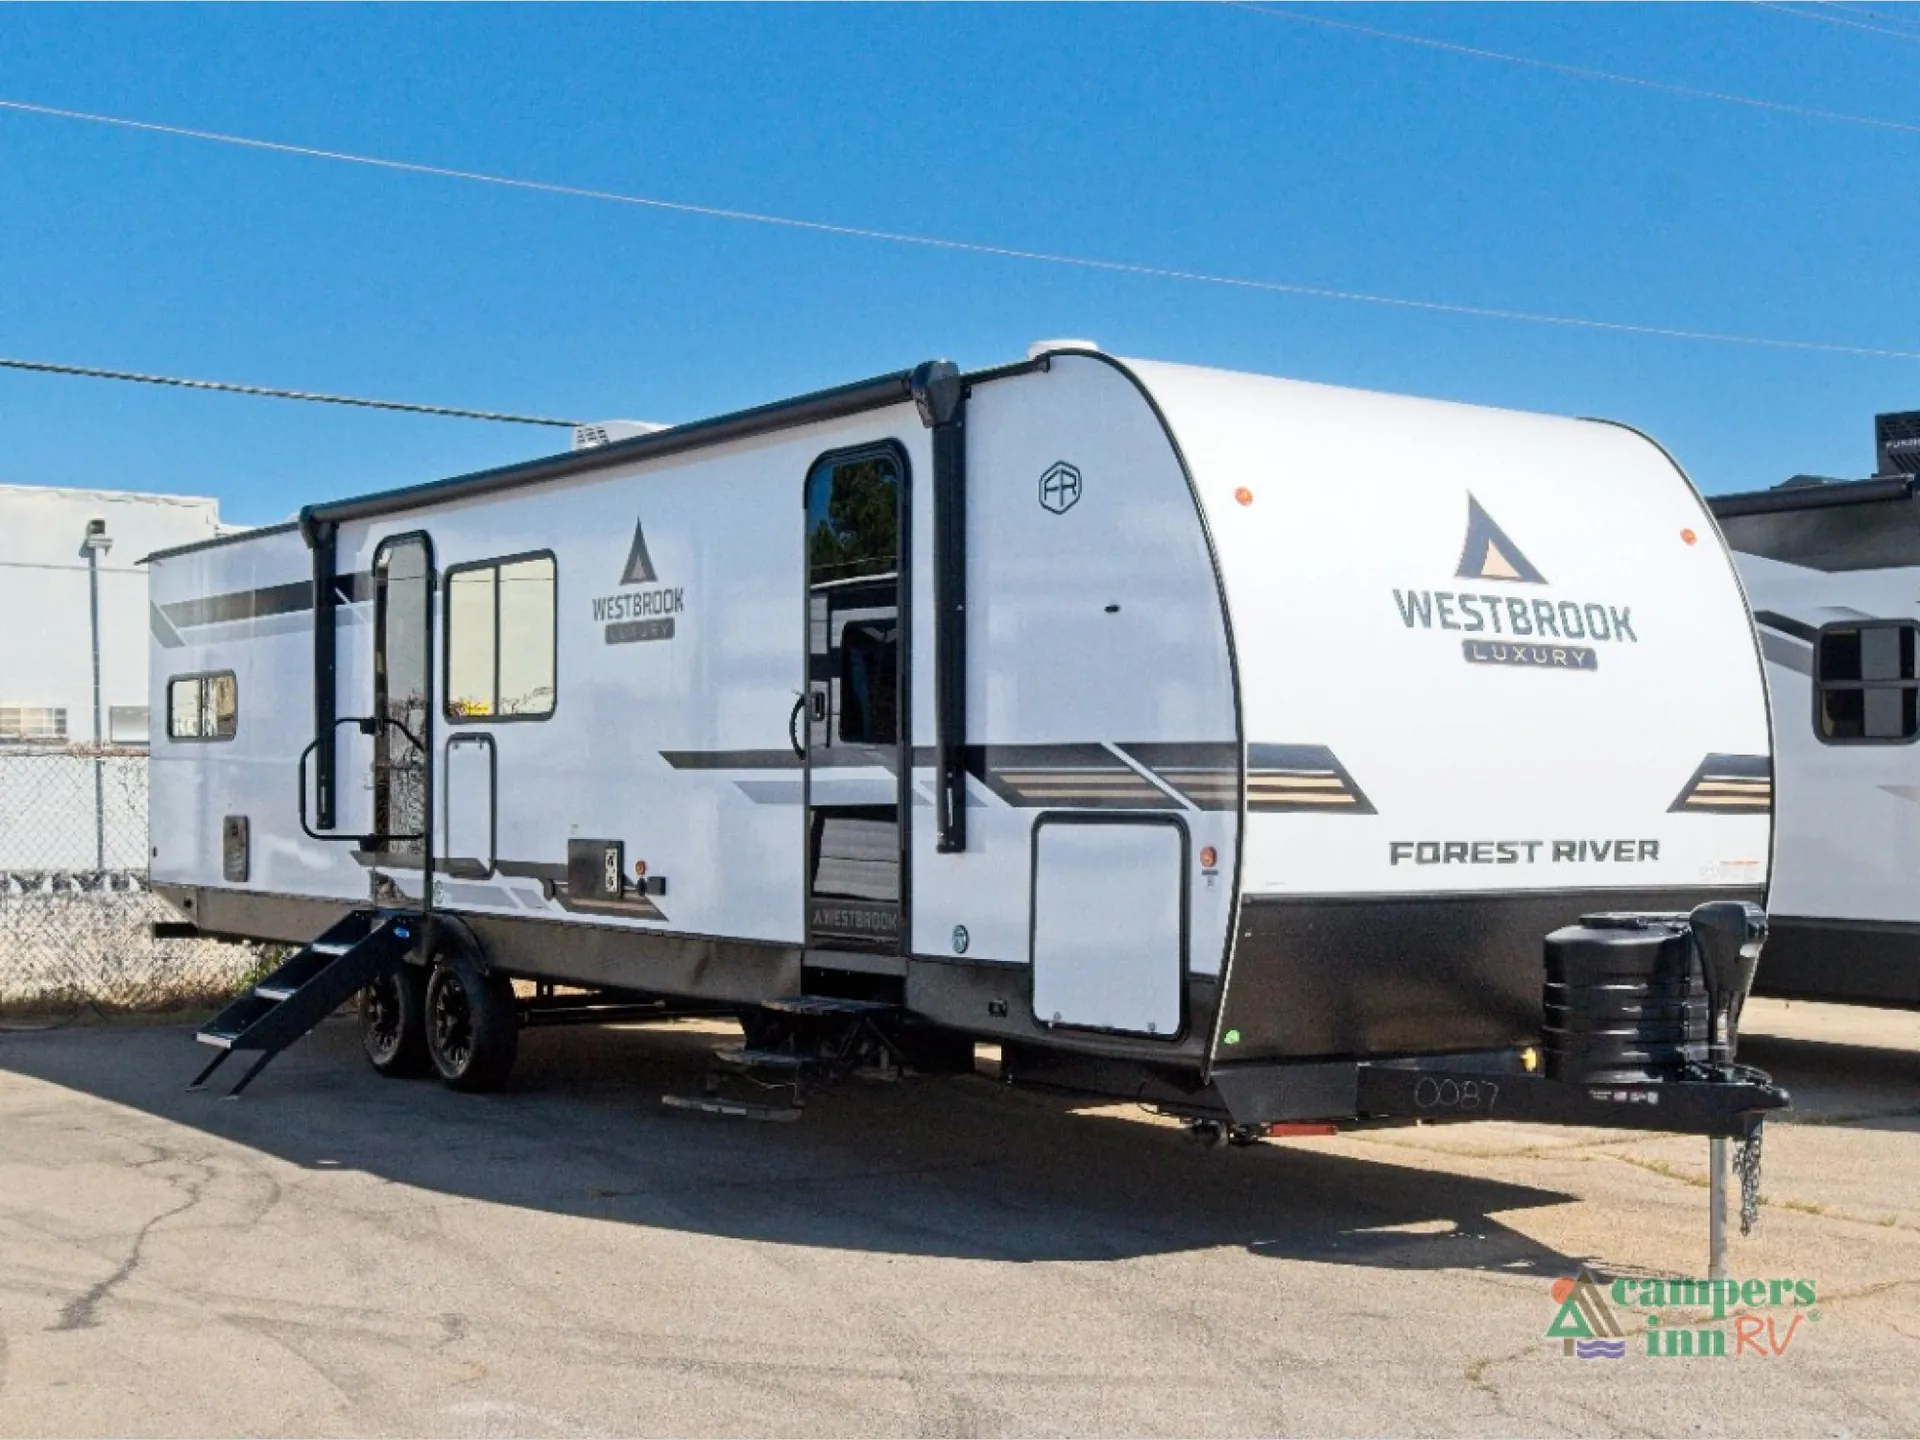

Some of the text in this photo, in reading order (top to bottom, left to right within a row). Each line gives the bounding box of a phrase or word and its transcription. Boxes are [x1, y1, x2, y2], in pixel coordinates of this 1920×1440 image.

[592, 587, 684, 620] WESTBROOK
[1392, 588, 1638, 643] WESTBROOK
[1471, 643, 1587, 666] LUXURY
[1389, 839, 1661, 866] FOREST RIVER
